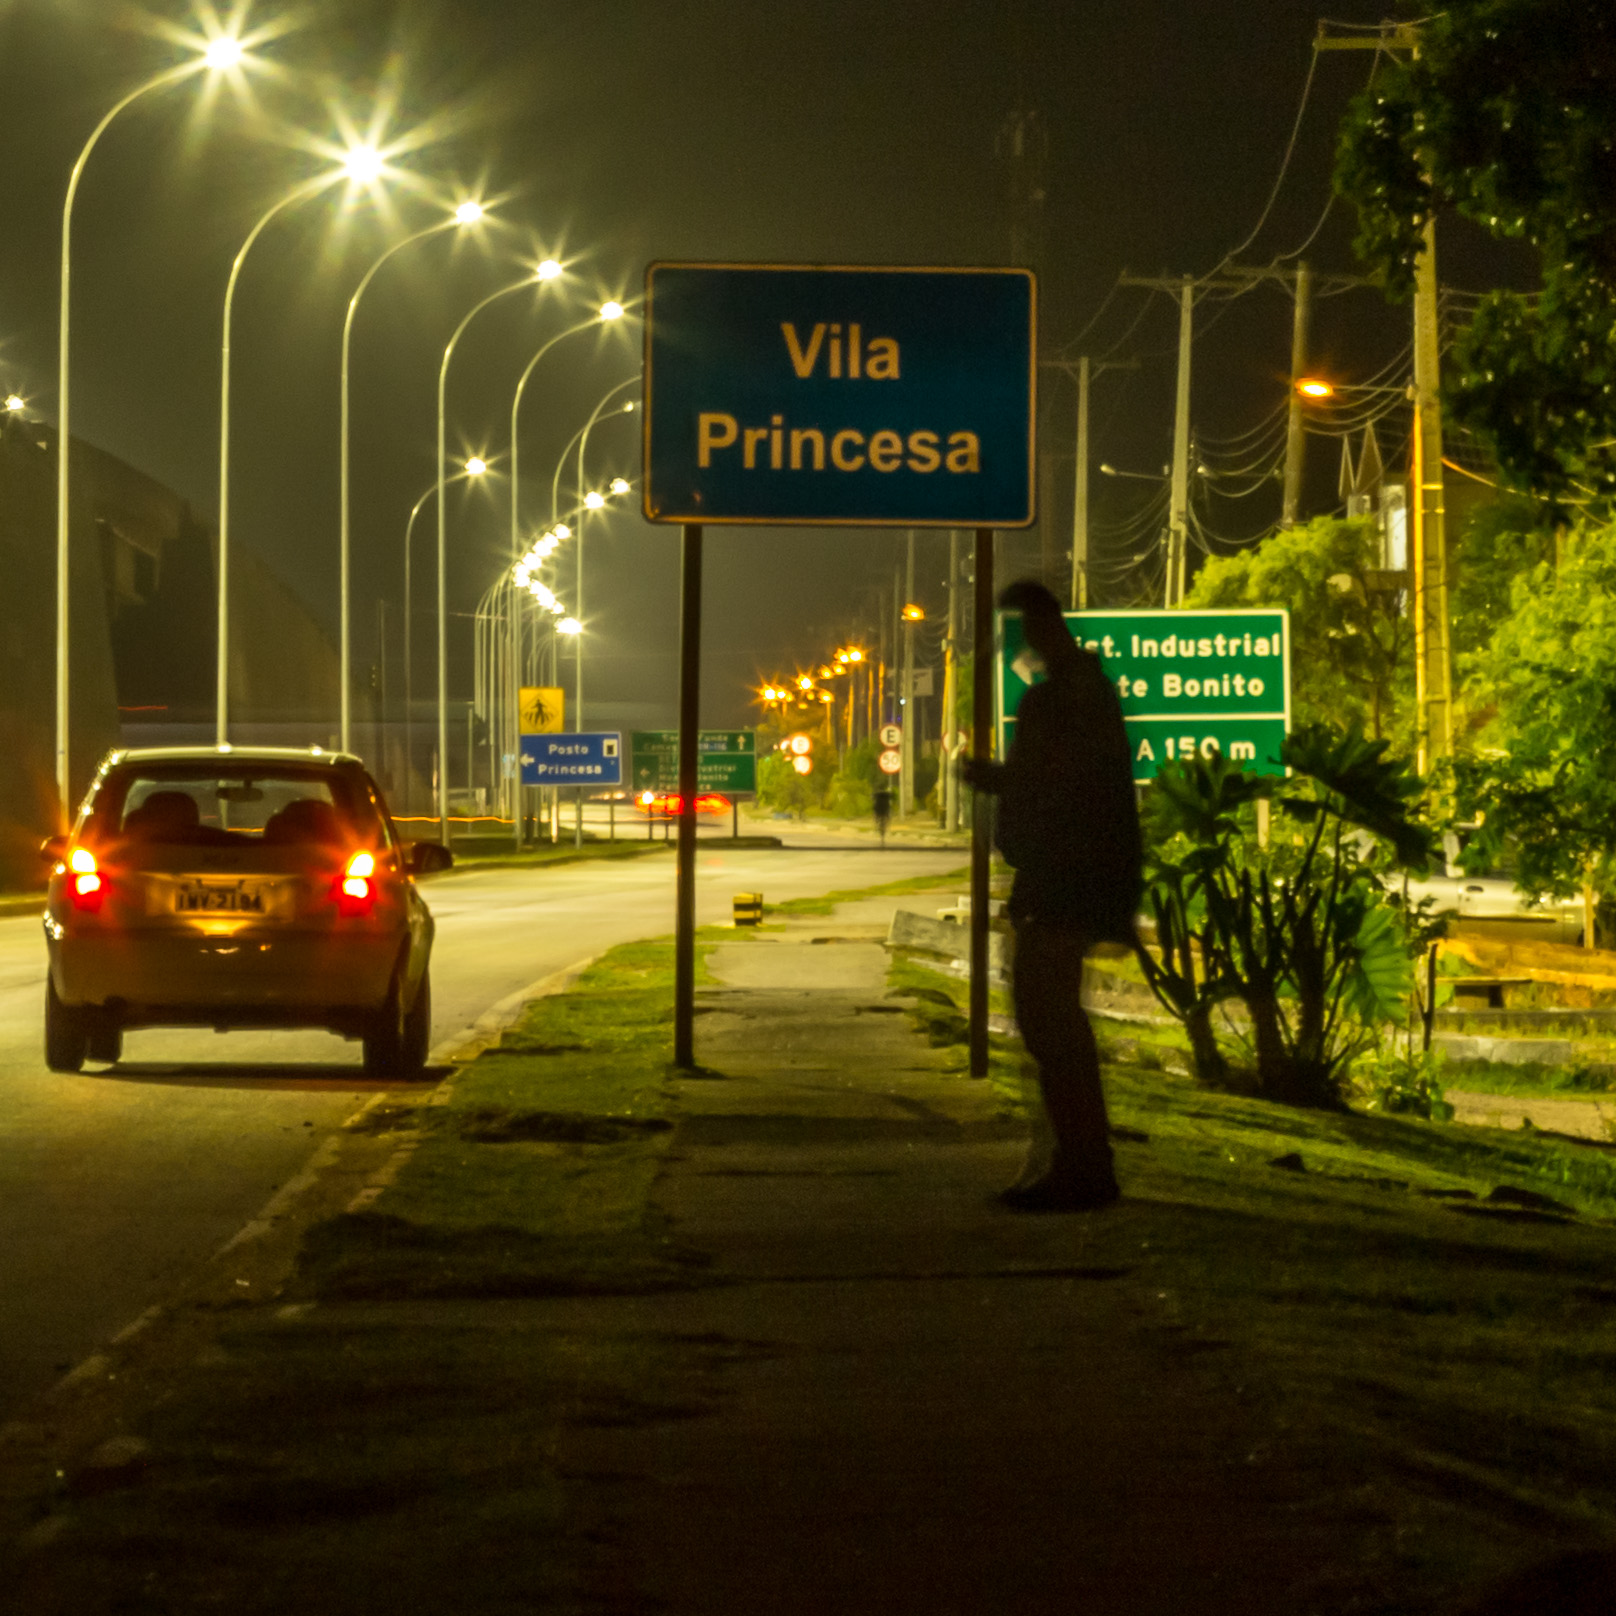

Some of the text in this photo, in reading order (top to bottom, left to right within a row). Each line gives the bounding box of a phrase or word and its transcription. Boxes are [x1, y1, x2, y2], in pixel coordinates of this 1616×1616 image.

[780, 322, 900, 380] Vila
[698, 412, 980, 474] Princesa
[1130, 632, 1281, 658] Industrial
[1162, 672, 1266, 698] Bonito
[886, 729, 895, 743] E
[1135, 736, 1256, 761] A 150 m
[548, 743, 589, 756] Posto
[537, 763, 603, 776] Princesa
